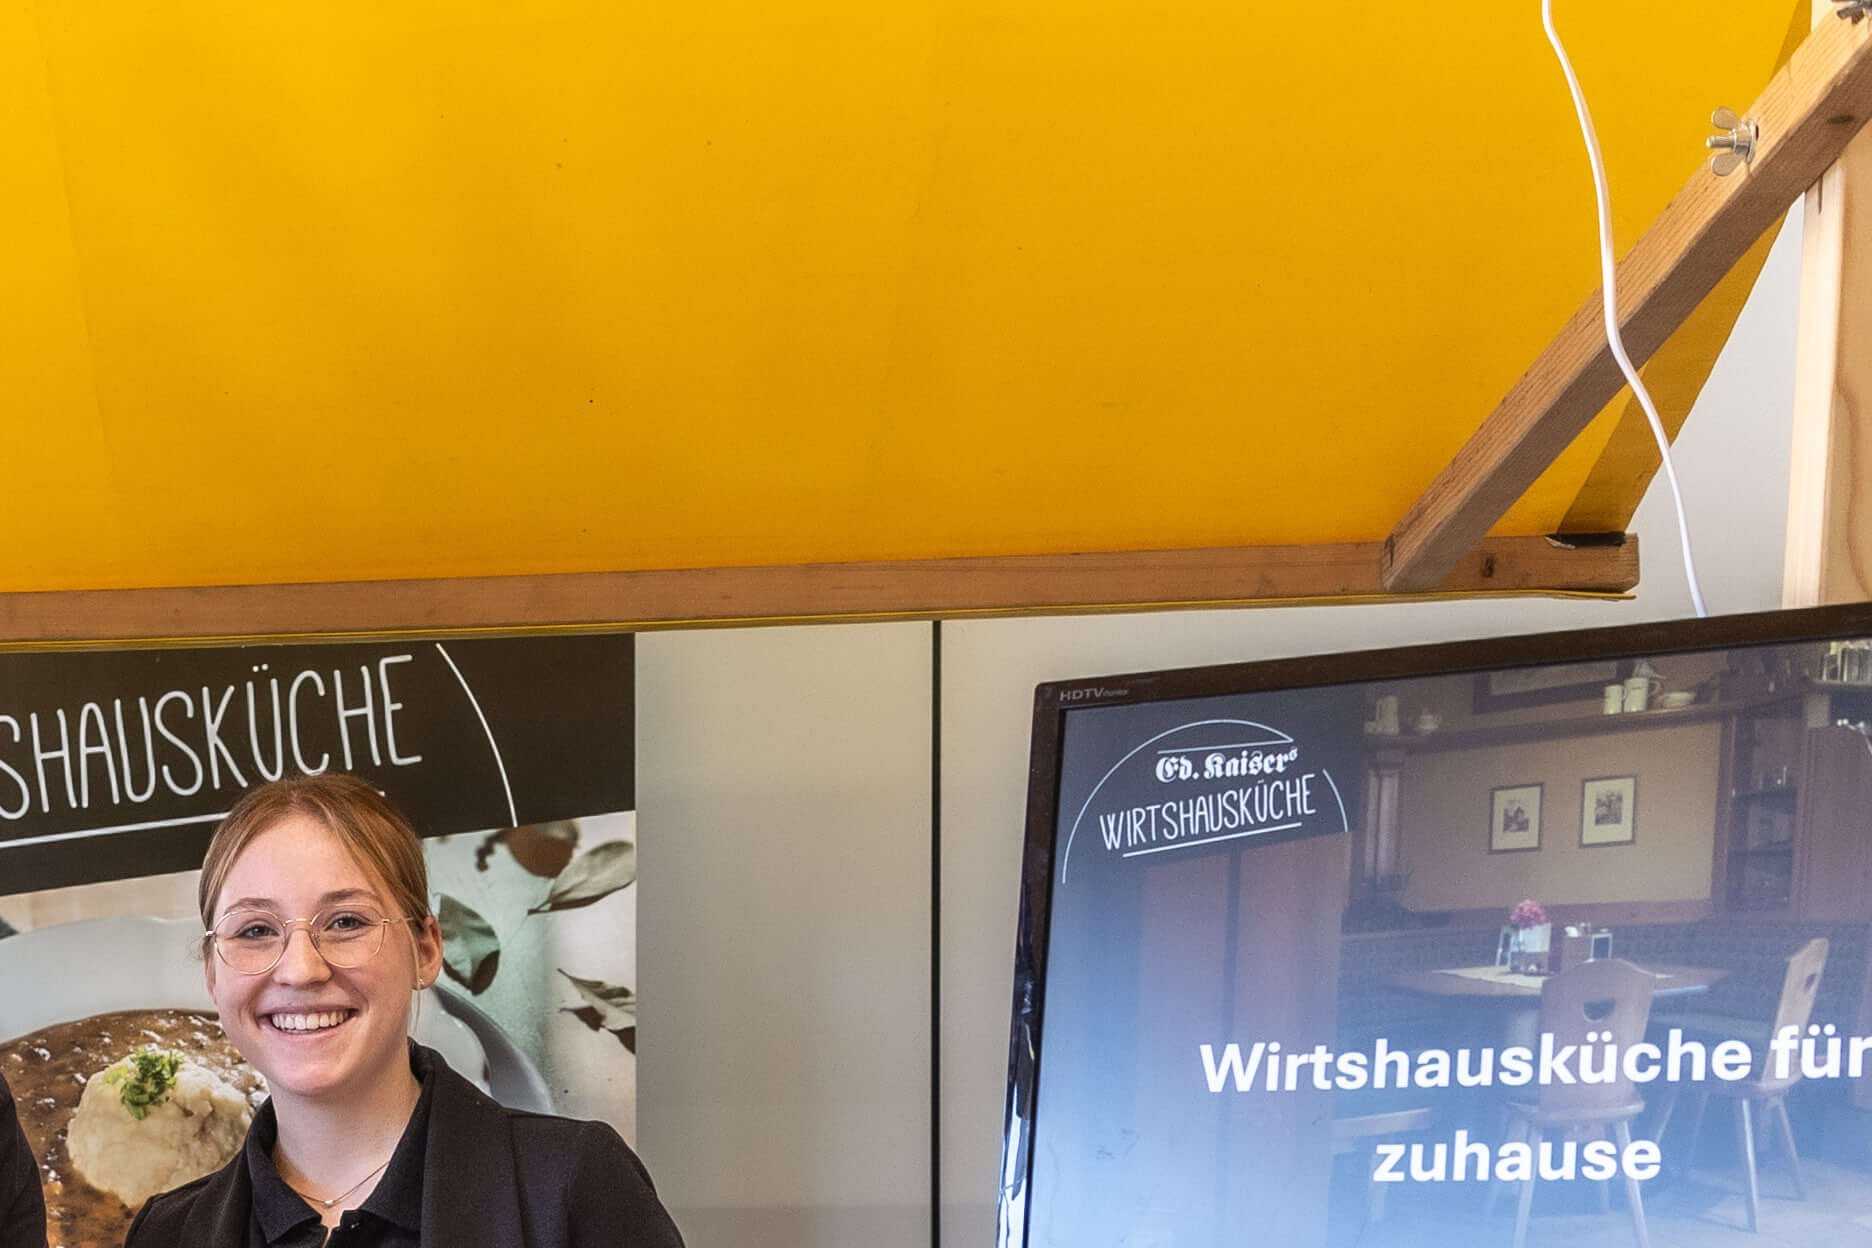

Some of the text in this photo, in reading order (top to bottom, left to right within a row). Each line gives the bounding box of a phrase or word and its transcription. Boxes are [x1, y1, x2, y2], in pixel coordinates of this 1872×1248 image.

[1060, 688, 1104, 701] HDTV
[1100, 774, 1317, 851] WIRTSHAUSKÜCHE
[1199, 1023, 1872, 1094] Wirtshausküche für
[1372, 1131, 1662, 1183] zuhause
